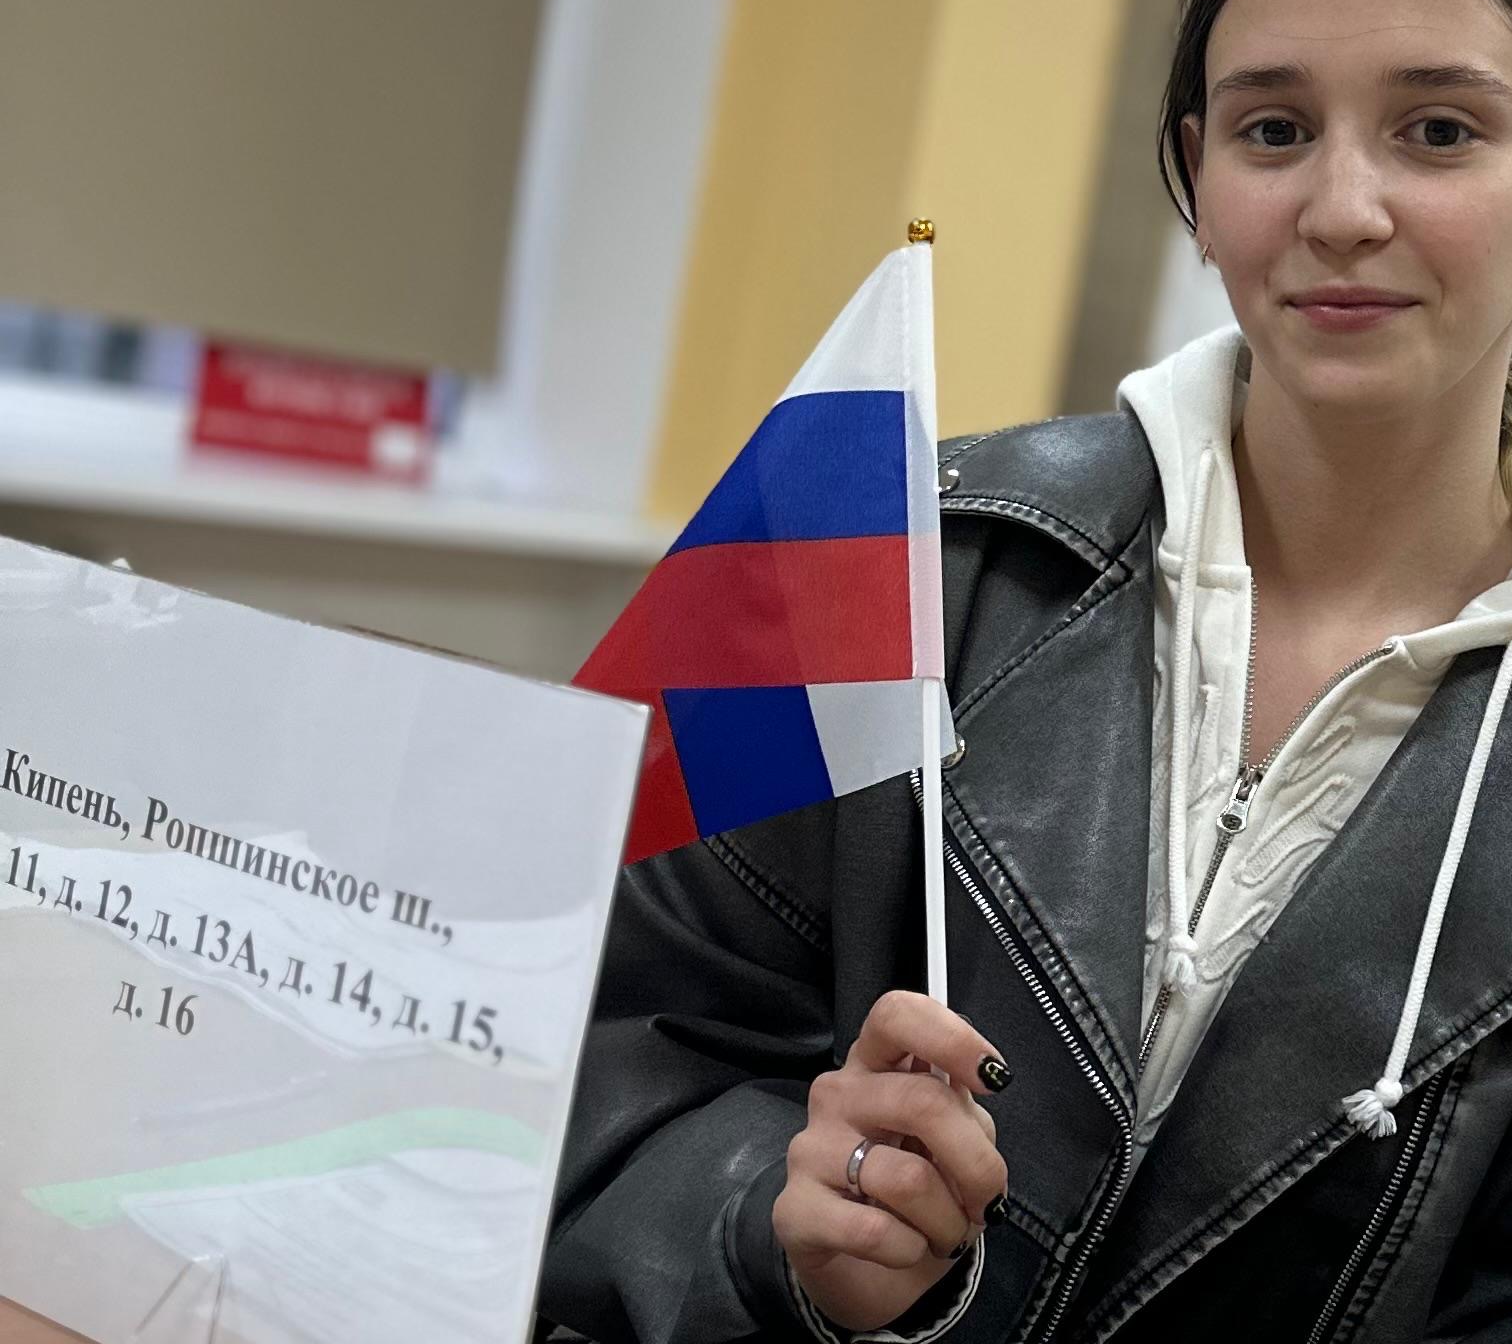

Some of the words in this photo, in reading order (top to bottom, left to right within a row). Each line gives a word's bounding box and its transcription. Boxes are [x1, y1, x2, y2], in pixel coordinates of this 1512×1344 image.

[0, 748, 130, 841] Кипень,
[141, 796, 380, 914] Ропшинское
[390, 889, 454, 947] ш.,
[5, 847, 47, 906] 11,
[53, 875, 83, 914] д.
[95, 879, 139, 941] 12,
[146, 909, 178, 951] д.
[190, 914, 270, 989] 13А,
[278, 956, 314, 999] д.
[327, 961, 382, 1027] 14,
[391, 993, 430, 1036] д.
[447, 999, 504, 1067] 15,
[112, 980, 143, 1022] д.
[155, 986, 200, 1036] 16
